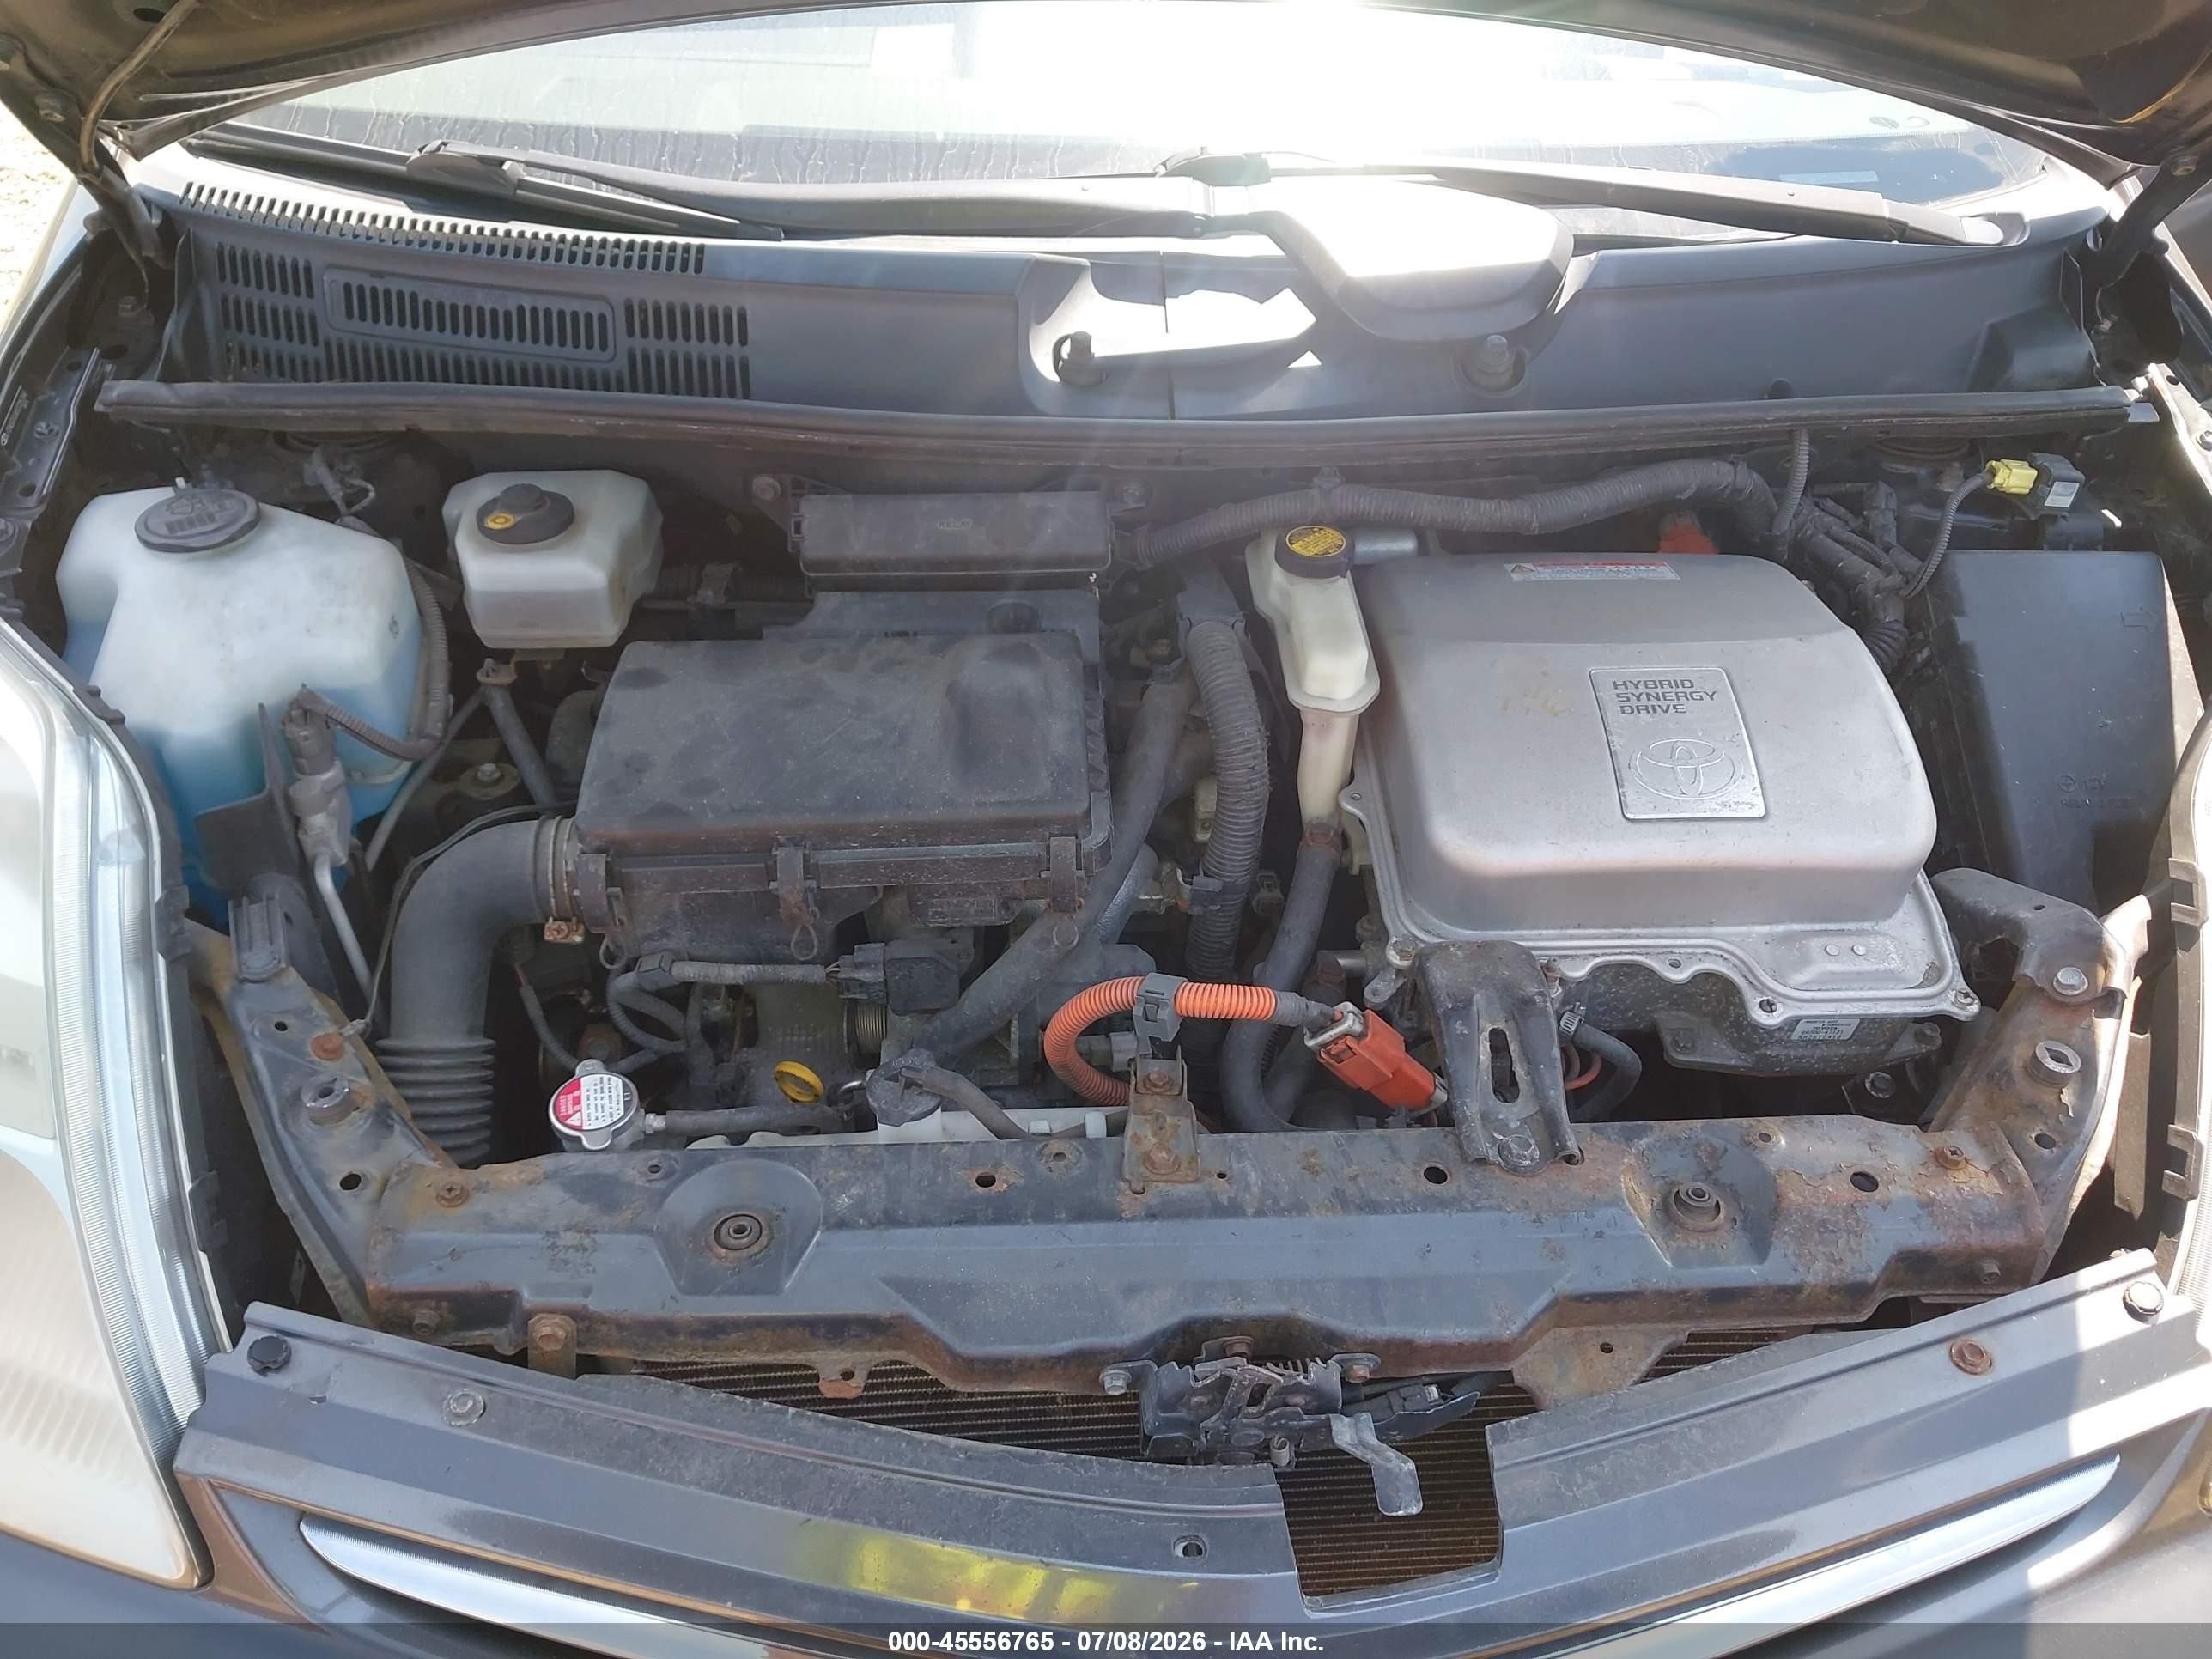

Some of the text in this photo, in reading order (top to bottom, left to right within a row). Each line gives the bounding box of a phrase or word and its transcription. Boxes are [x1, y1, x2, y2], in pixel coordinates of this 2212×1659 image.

[1612, 679, 1694, 690] HYBRID
[1616, 690, 1717, 702] SYNERGY
[1620, 704, 1687, 714] DRIVE
